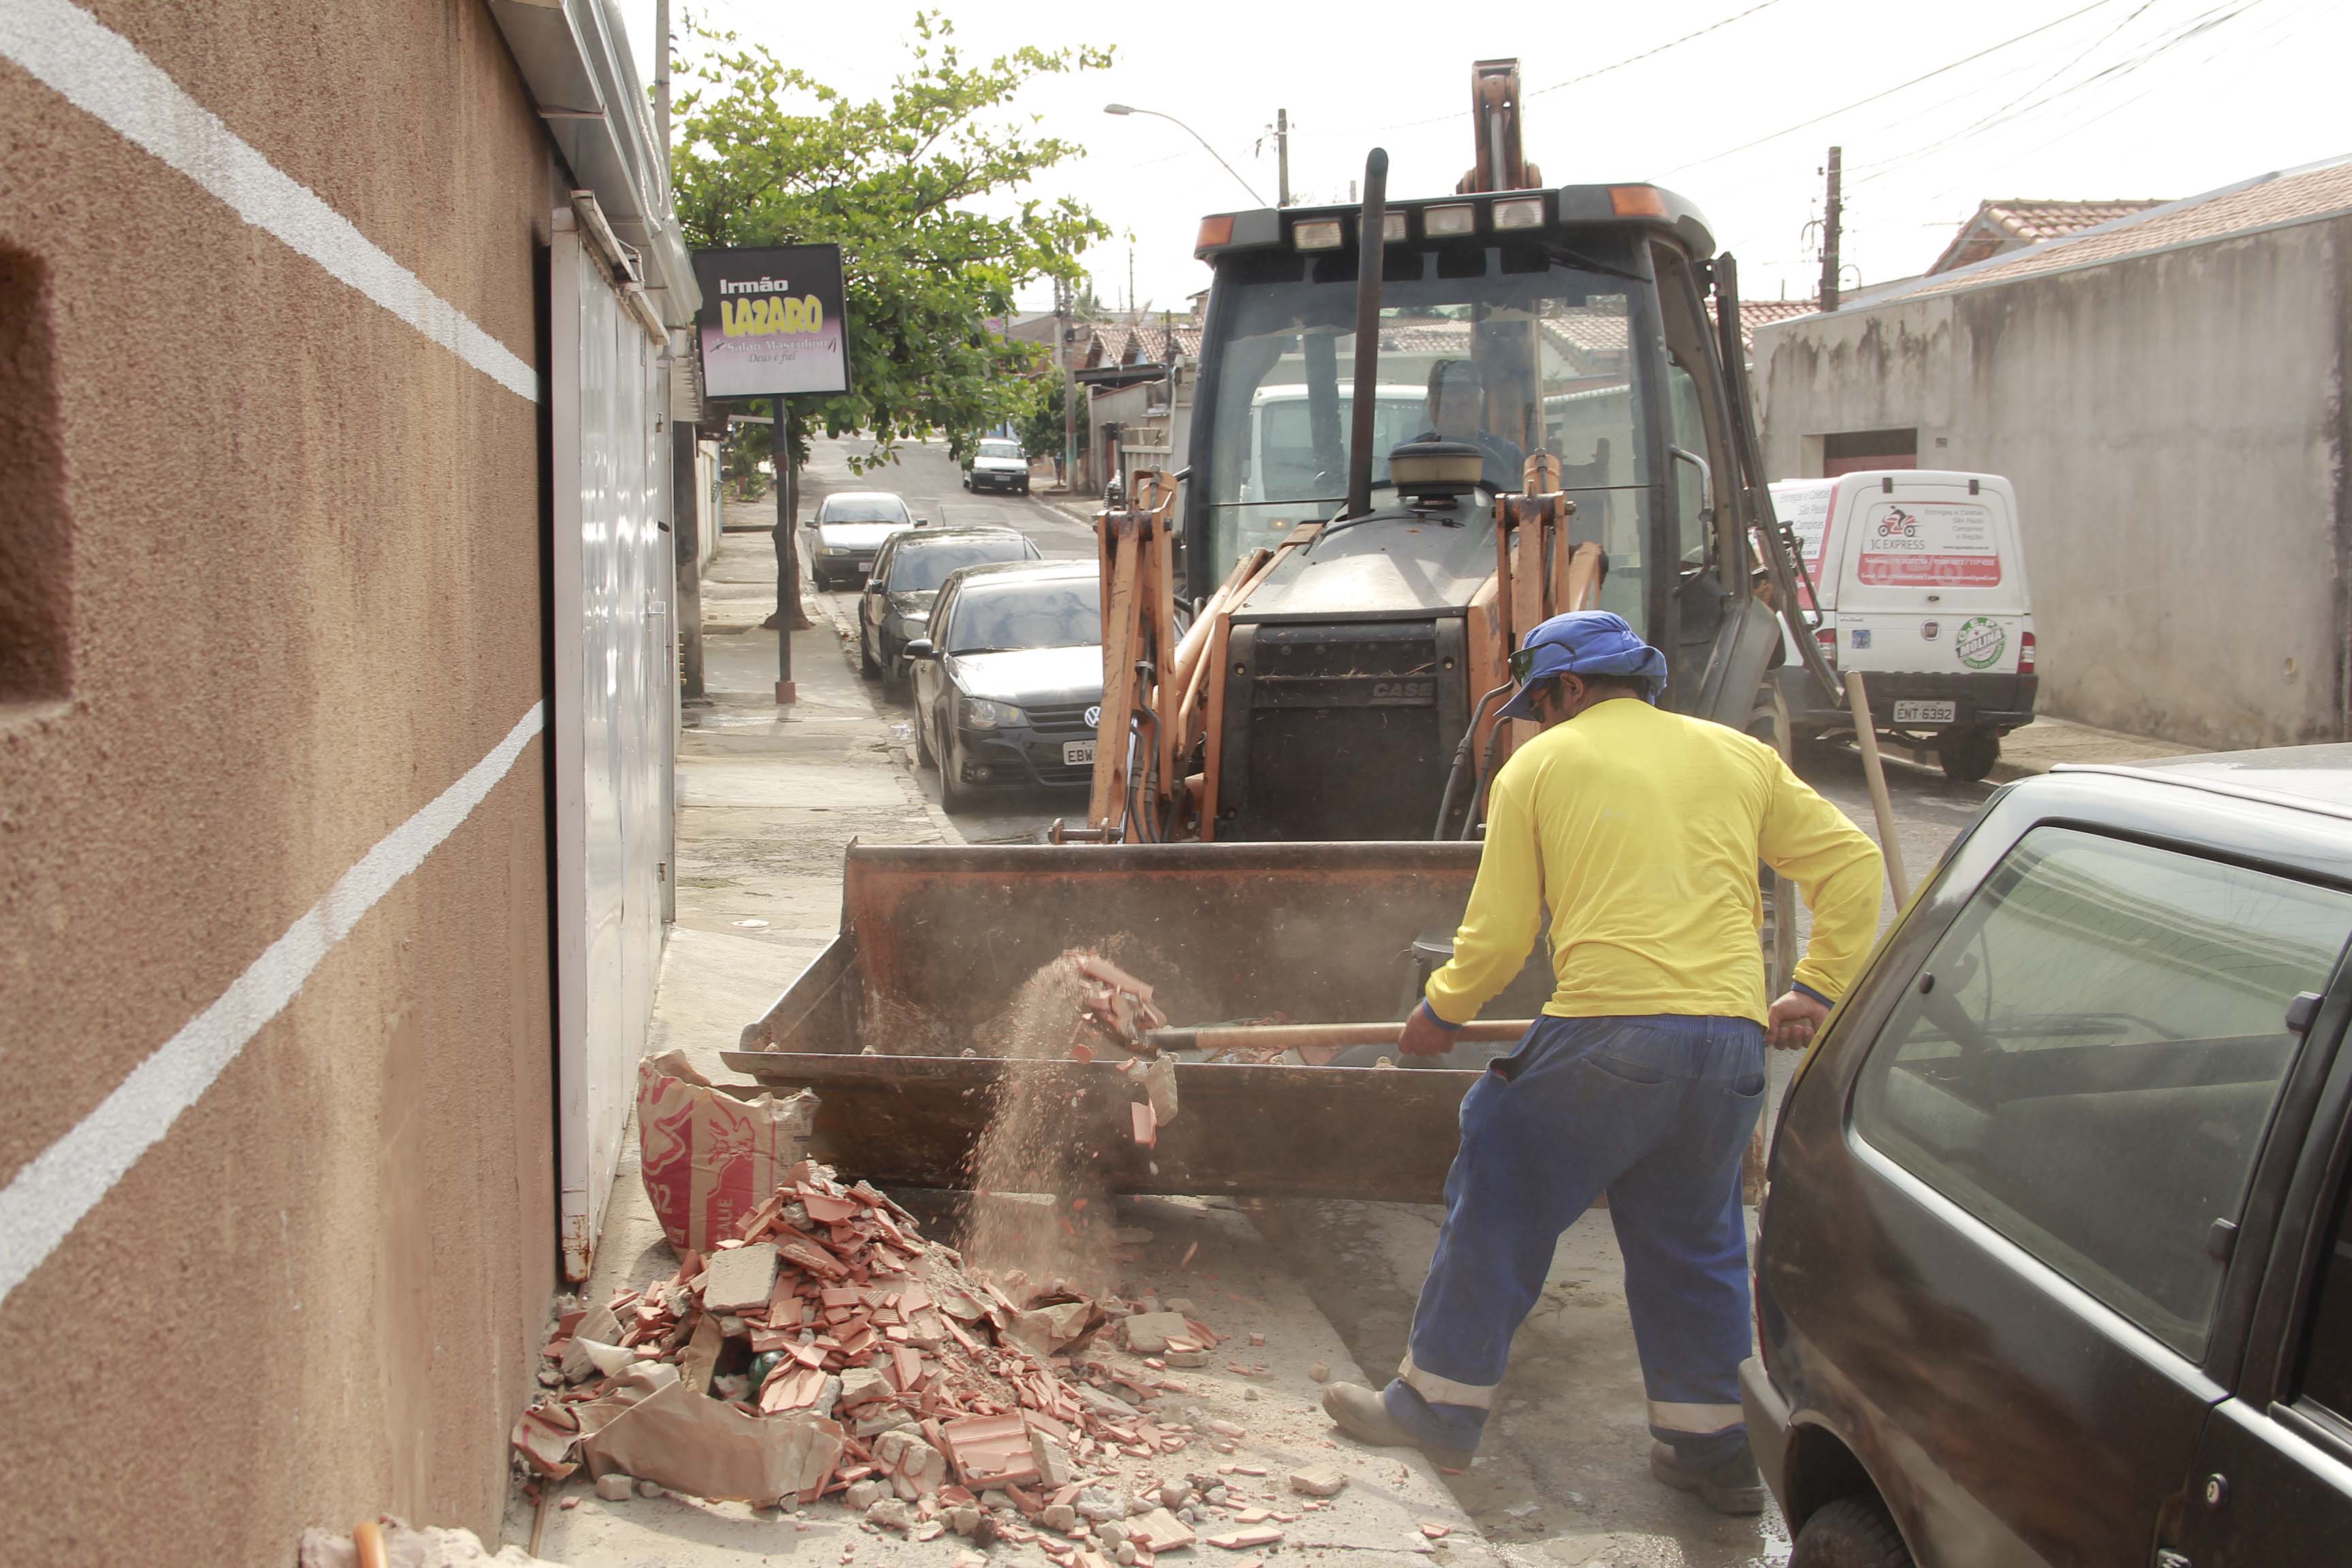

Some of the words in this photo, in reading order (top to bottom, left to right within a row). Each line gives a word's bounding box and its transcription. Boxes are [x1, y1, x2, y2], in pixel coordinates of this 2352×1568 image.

[720, 276, 788, 294] Irmão
[721, 294, 823, 338] LAZARO
[749, 353, 771, 363] Deus
[779, 350, 796, 365] fiel
[1870, 539, 1881, 551] JC
[1883, 539, 1925, 551] EXPRESS
[1959, 628, 2003, 657] MOLINA
[1372, 682, 1435, 698] CASE
